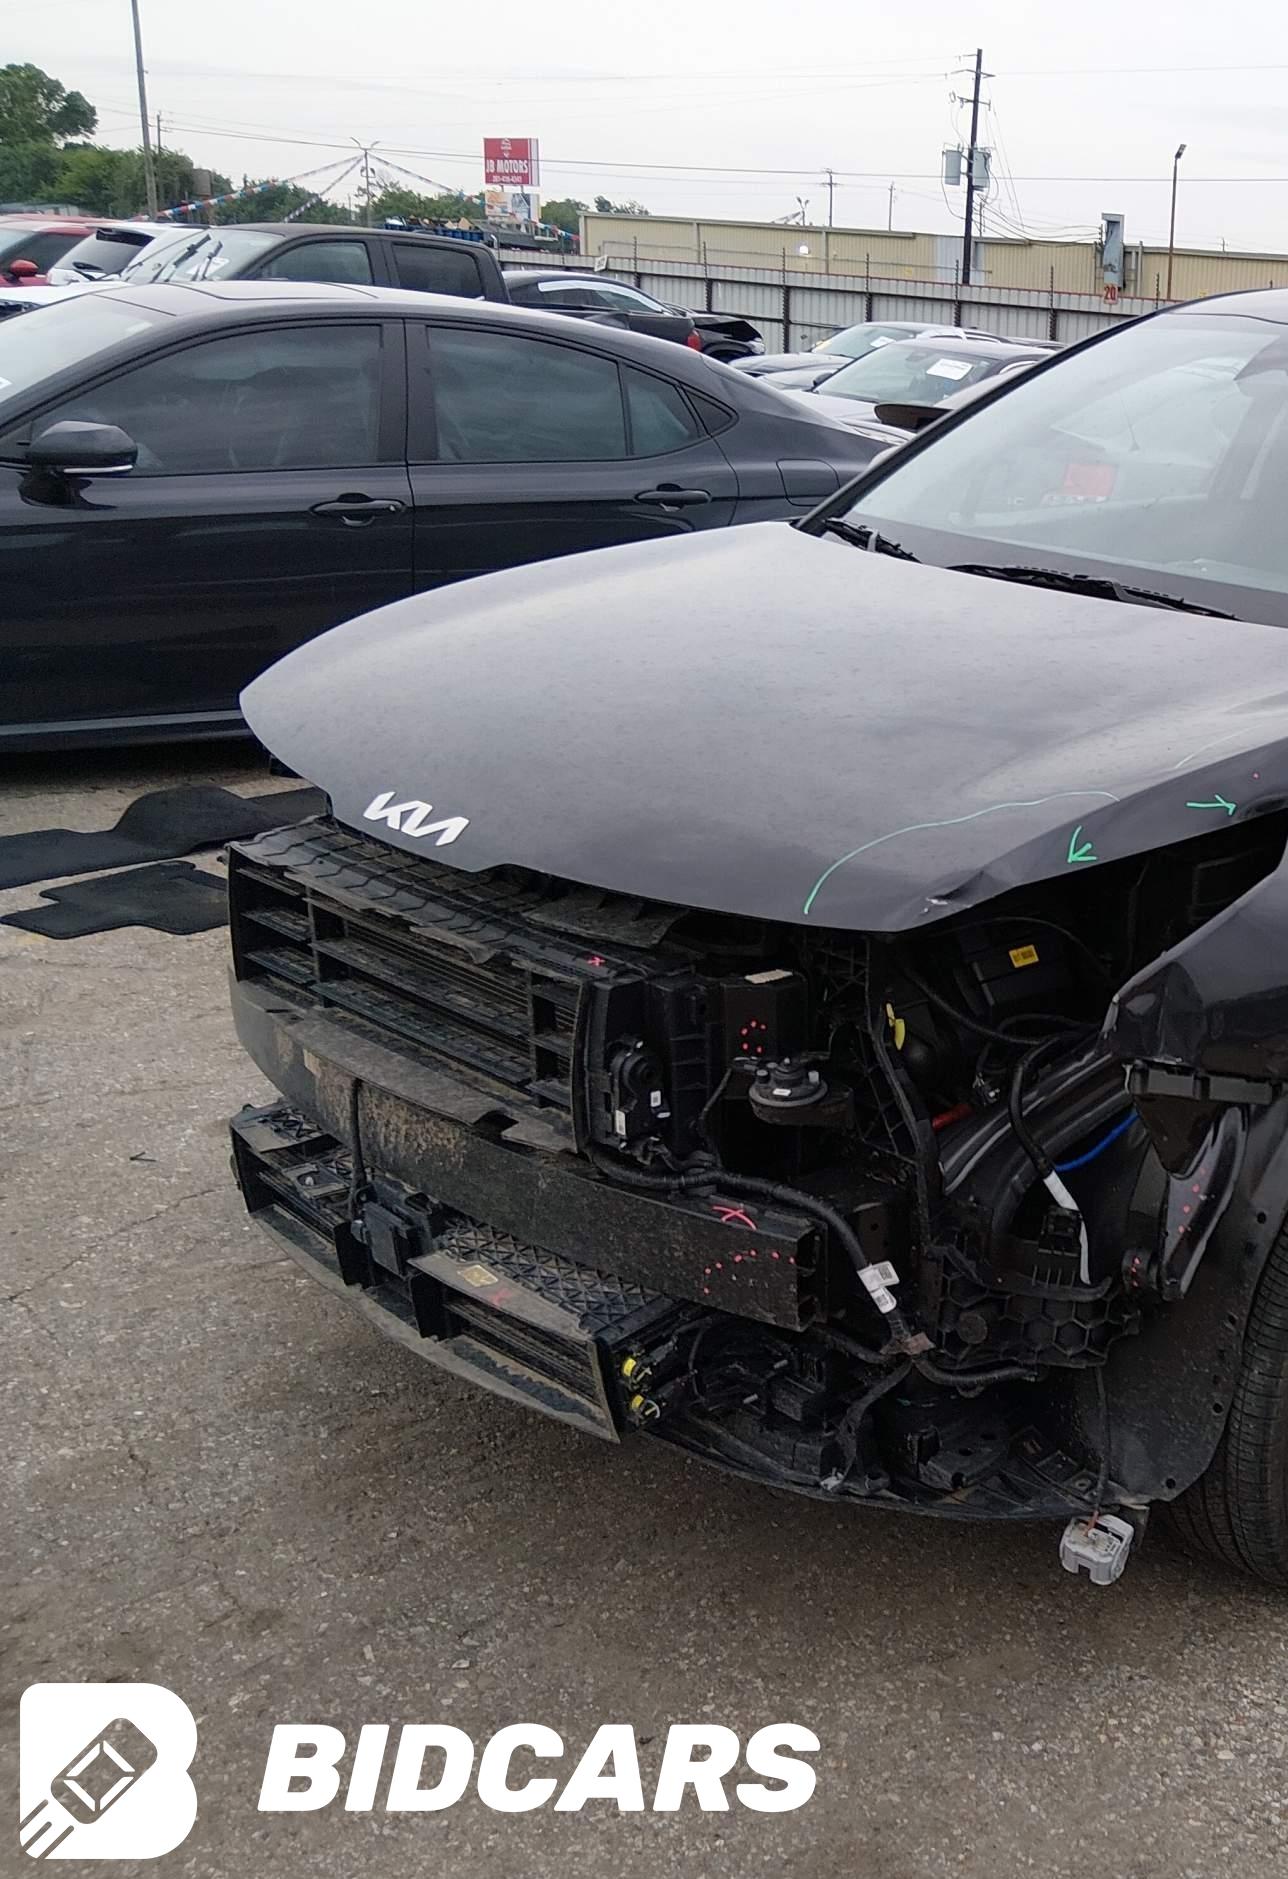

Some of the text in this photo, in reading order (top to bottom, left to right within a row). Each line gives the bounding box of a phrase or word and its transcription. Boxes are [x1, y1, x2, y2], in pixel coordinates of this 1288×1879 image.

[486, 159, 528, 173] JB MOTORS
[1104, 285, 1116, 300] 20
[363, 791, 470, 846] KIA
